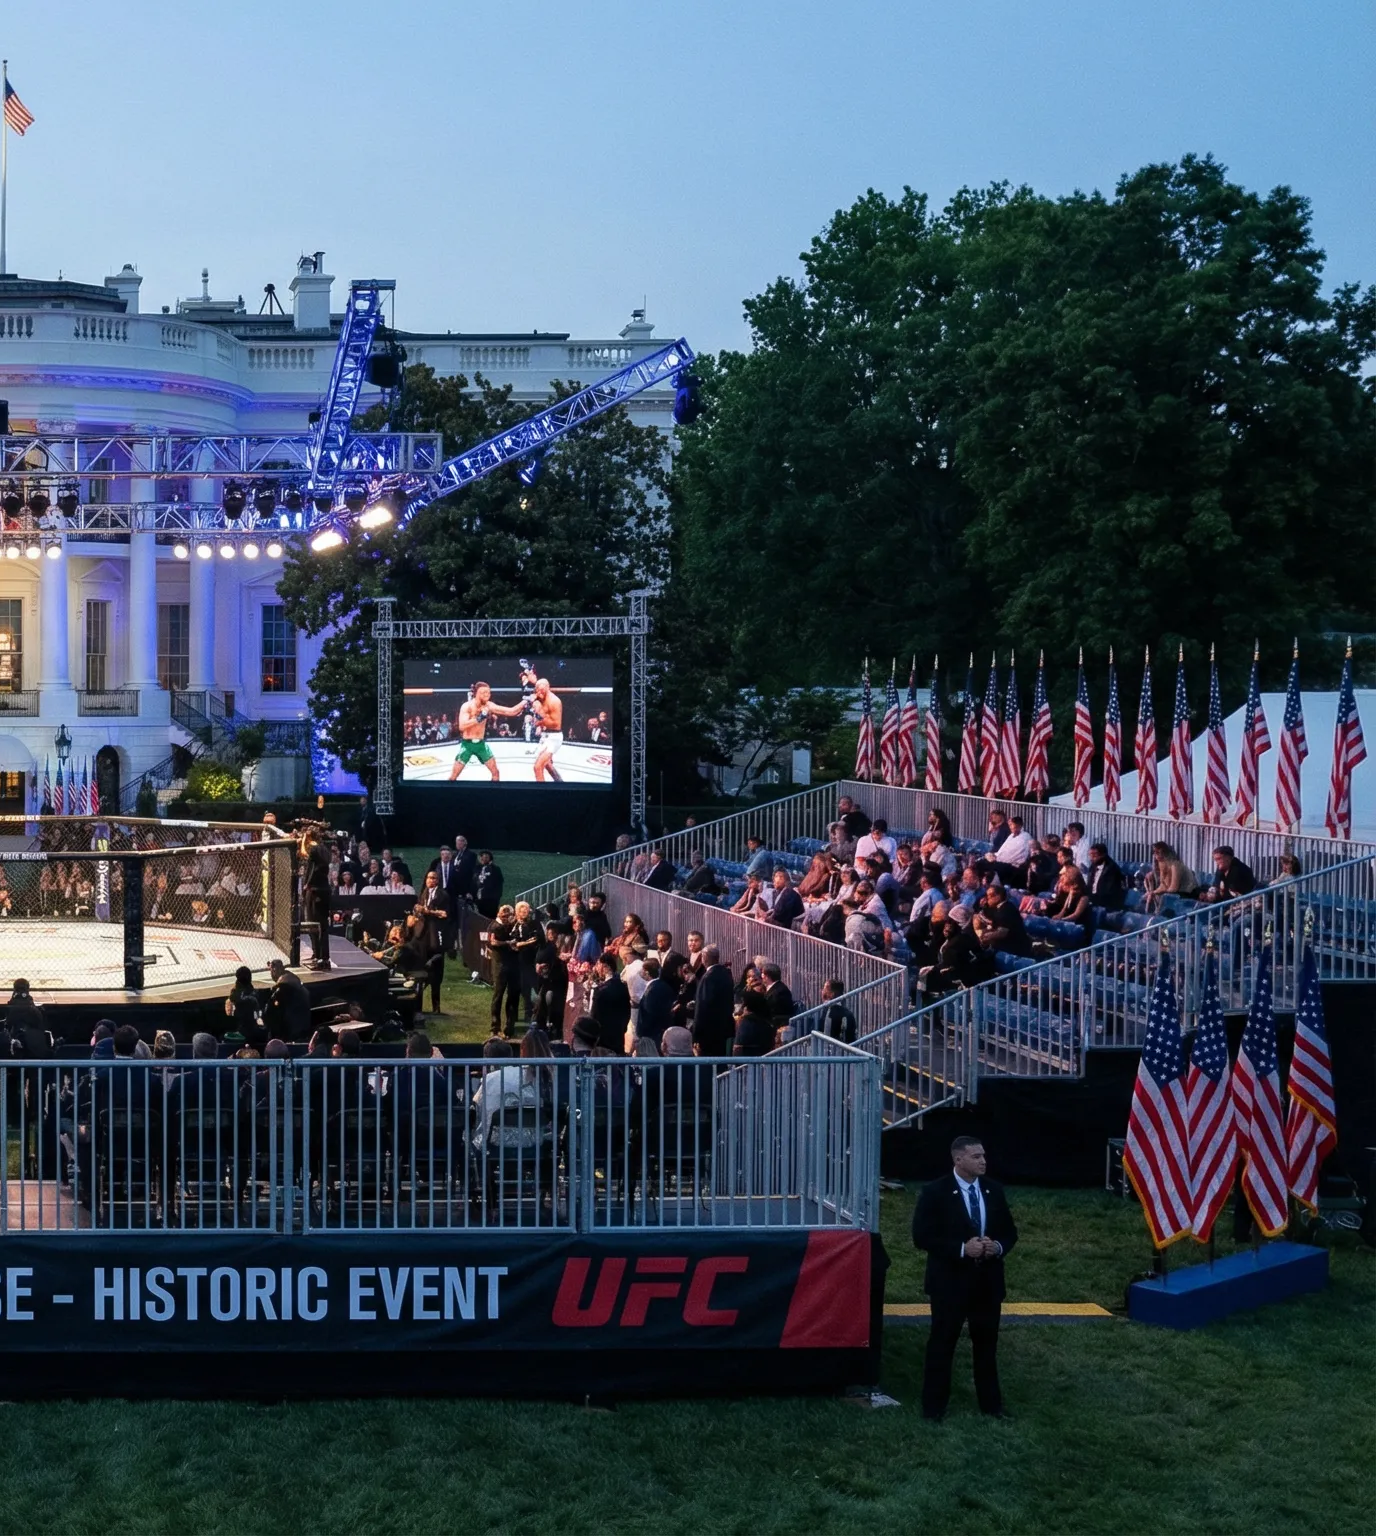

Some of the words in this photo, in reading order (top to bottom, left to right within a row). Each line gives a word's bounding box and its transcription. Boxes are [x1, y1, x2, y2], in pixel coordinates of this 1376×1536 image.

[94, 1266, 328, 1322] HISTORIC
[349, 1266, 509, 1320] EVENT
[552, 1257, 749, 1326] UFC
